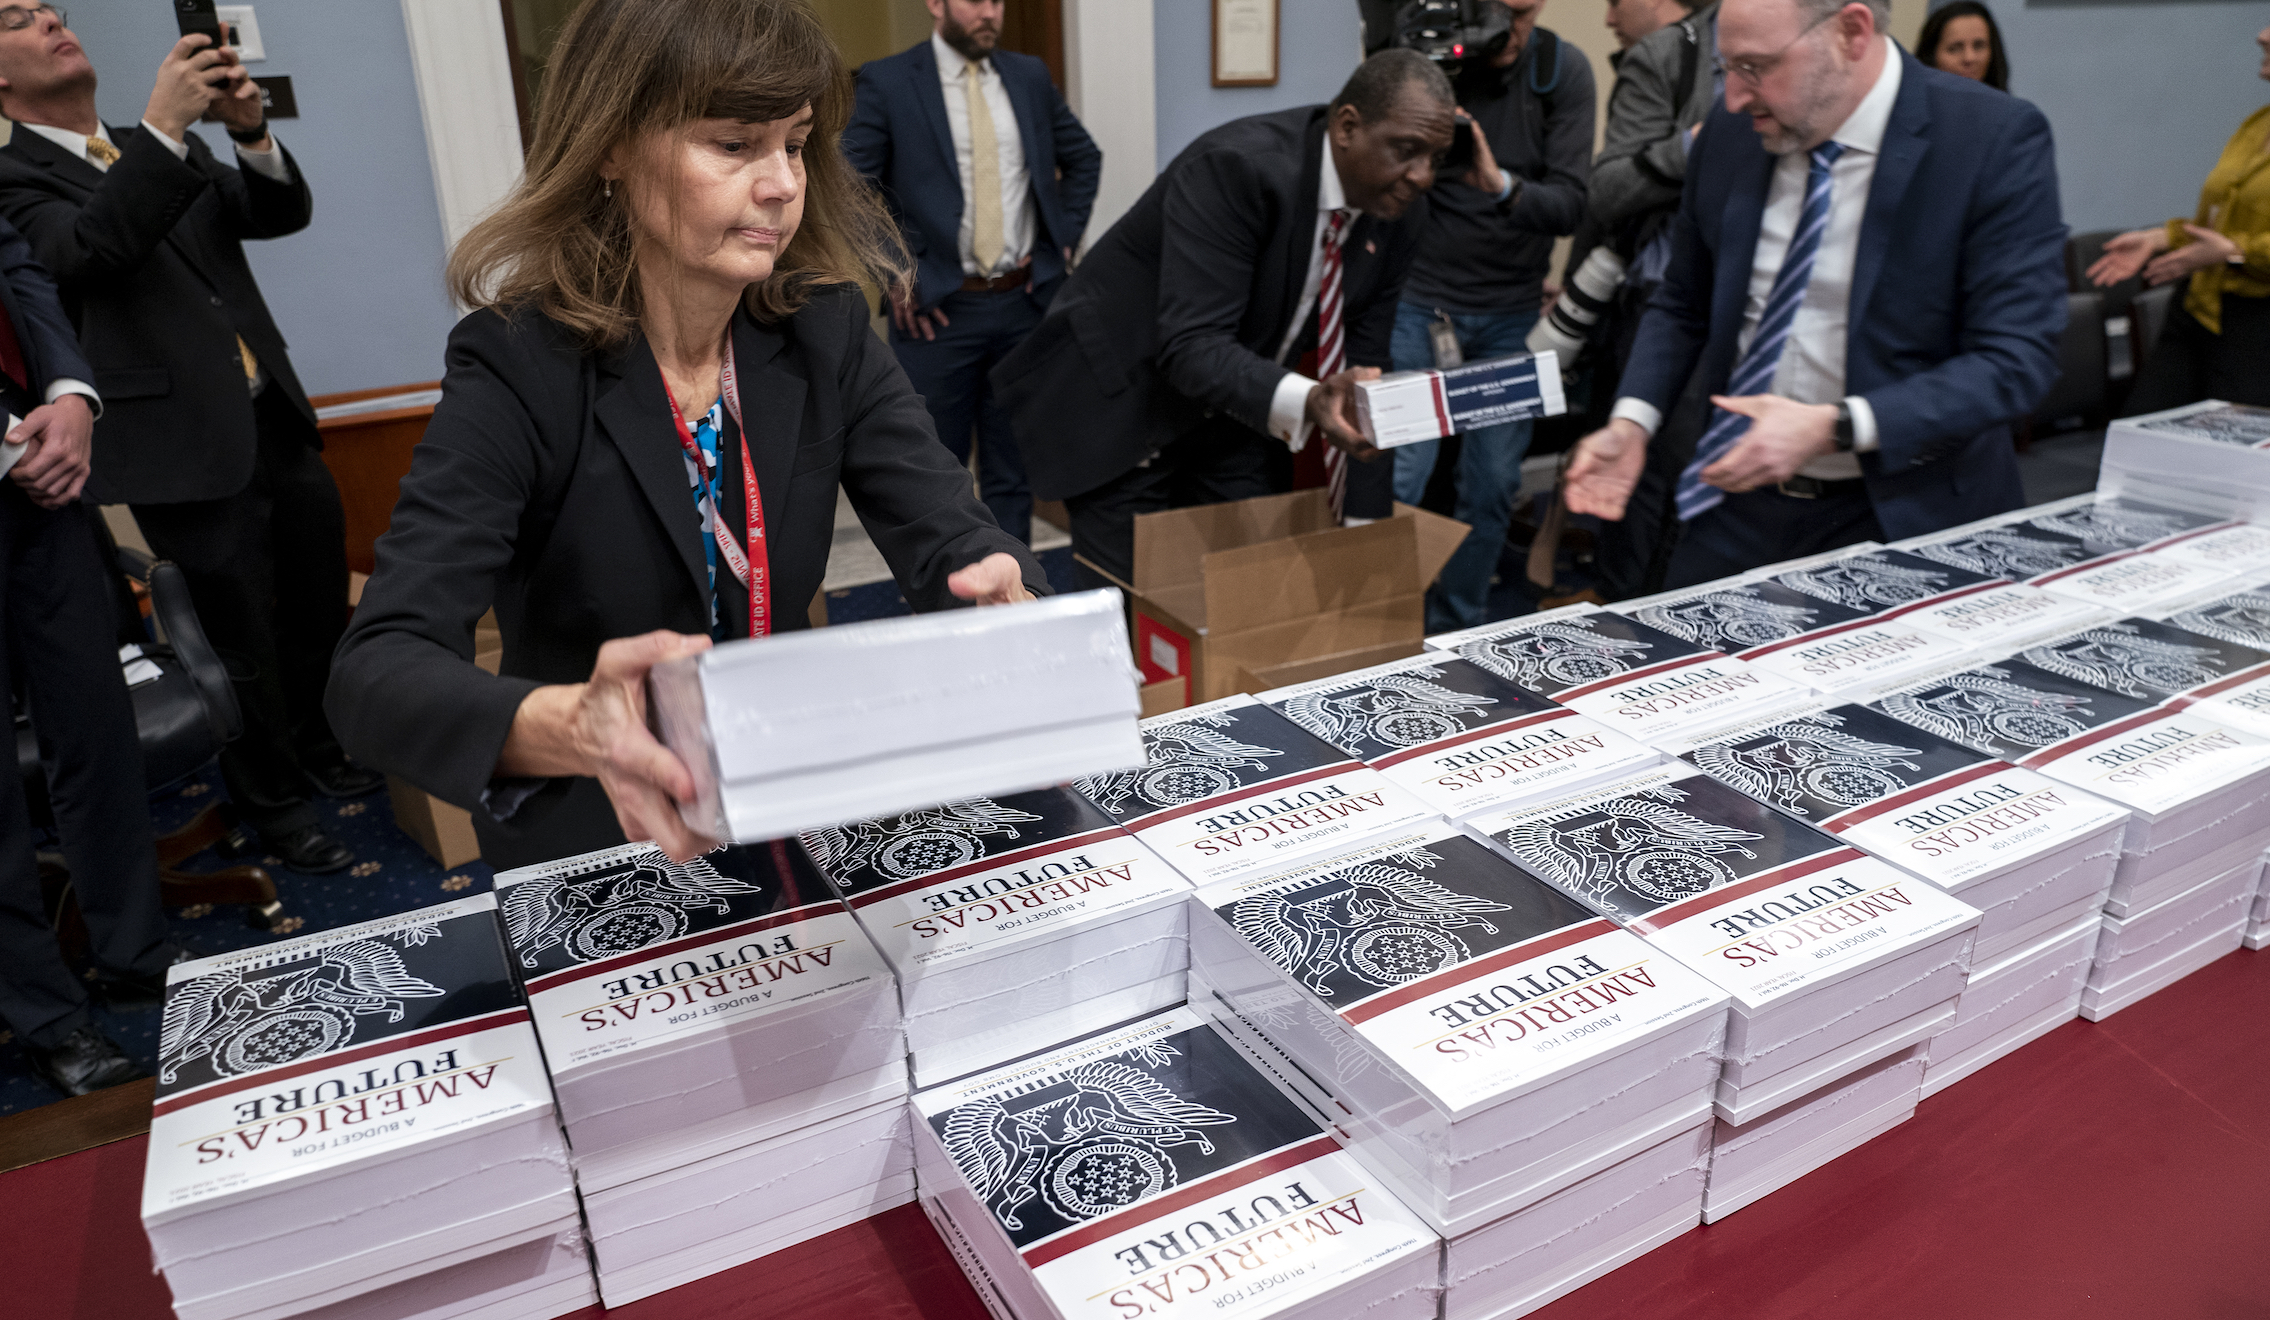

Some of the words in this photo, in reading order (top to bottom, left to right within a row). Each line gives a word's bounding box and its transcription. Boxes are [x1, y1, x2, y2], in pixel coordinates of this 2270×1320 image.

[749, 486, 760, 523] What's
[753, 566, 764, 604] OFFICE
[754, 606, 764, 617] ID
[1792, 631, 1894, 661] FUTURE
[1610, 668, 1725, 704] FUTURE
[1619, 673, 1759, 719] AMERICA'S
[1432, 728, 1570, 772] FUTURE
[2088, 726, 2196, 769] FUTURE
[1438, 735, 1605, 791] AMERICA'S
[1194, 784, 1349, 834] FUTURE
[1892, 783, 2024, 834] FUTURE
[1194, 791, 1385, 856] AMERICA'S
[1297, 826, 1341, 842] BUDGET
[1912, 791, 2068, 857] AMERICA'S
[1270, 839, 1296, 849] FOR
[1387, 836, 1427, 851] BUDGET
[1344, 854, 1367, 863] THE
[920, 854, 1097, 913] FUTURE
[1242, 868, 1317, 893] GOVERNMENT
[911, 864, 1132, 938] AMERICA'S
[1026, 904, 1076, 923] BUDGET
[1709, 876, 1865, 940] FUTURE
[403, 910, 454, 925] BUDGET
[994, 919, 1022, 931] FOR
[1725, 887, 1912, 968] AMERICA'S
[350, 929, 374, 938] THE
[1835, 930, 1880, 950] BUDGET
[216, 943, 308, 968] GOVERNMENT
[1809, 946, 1838, 959] FOR
[600, 933, 799, 1001] FUTURE
[578, 946, 832, 1032] AMERICA'S
[762, 990, 771, 998] A
[1427, 954, 1609, 1030] FUTURE
[667, 1010, 697, 1025] FOR
[703, 994, 760, 1016] BUDGET
[1436, 966, 1657, 1064] AMERICA'S
[1608, 1013, 1621, 1022] A
[1127, 1024, 1172, 1044] BUDGET
[1561, 1018, 1613, 1042] BUDGET
[1079, 1048, 1103, 1060] THE
[1109, 1042, 1123, 1050] OF
[1530, 1037, 1562, 1053] FOR
[232, 1048, 461, 1126] FUTURE
[964, 1067, 1046, 1098] GOVERNMENT
[194, 1064, 499, 1164] AMERICA'S
[404, 1116, 416, 1127] A
[331, 1121, 399, 1147] BUDGET
[1105, 1122, 1161, 1134] PLURIBUS
[292, 1141, 325, 1158] FOR
[1015, 1158, 1041, 1184] UNUM
[1112, 1181, 1320, 1277] FUTURE
[1108, 1198, 1366, 1319] AMERICA'S
[1247, 1265, 1306, 1296] BUDGET
[1211, 1289, 1245, 1309] FOR
